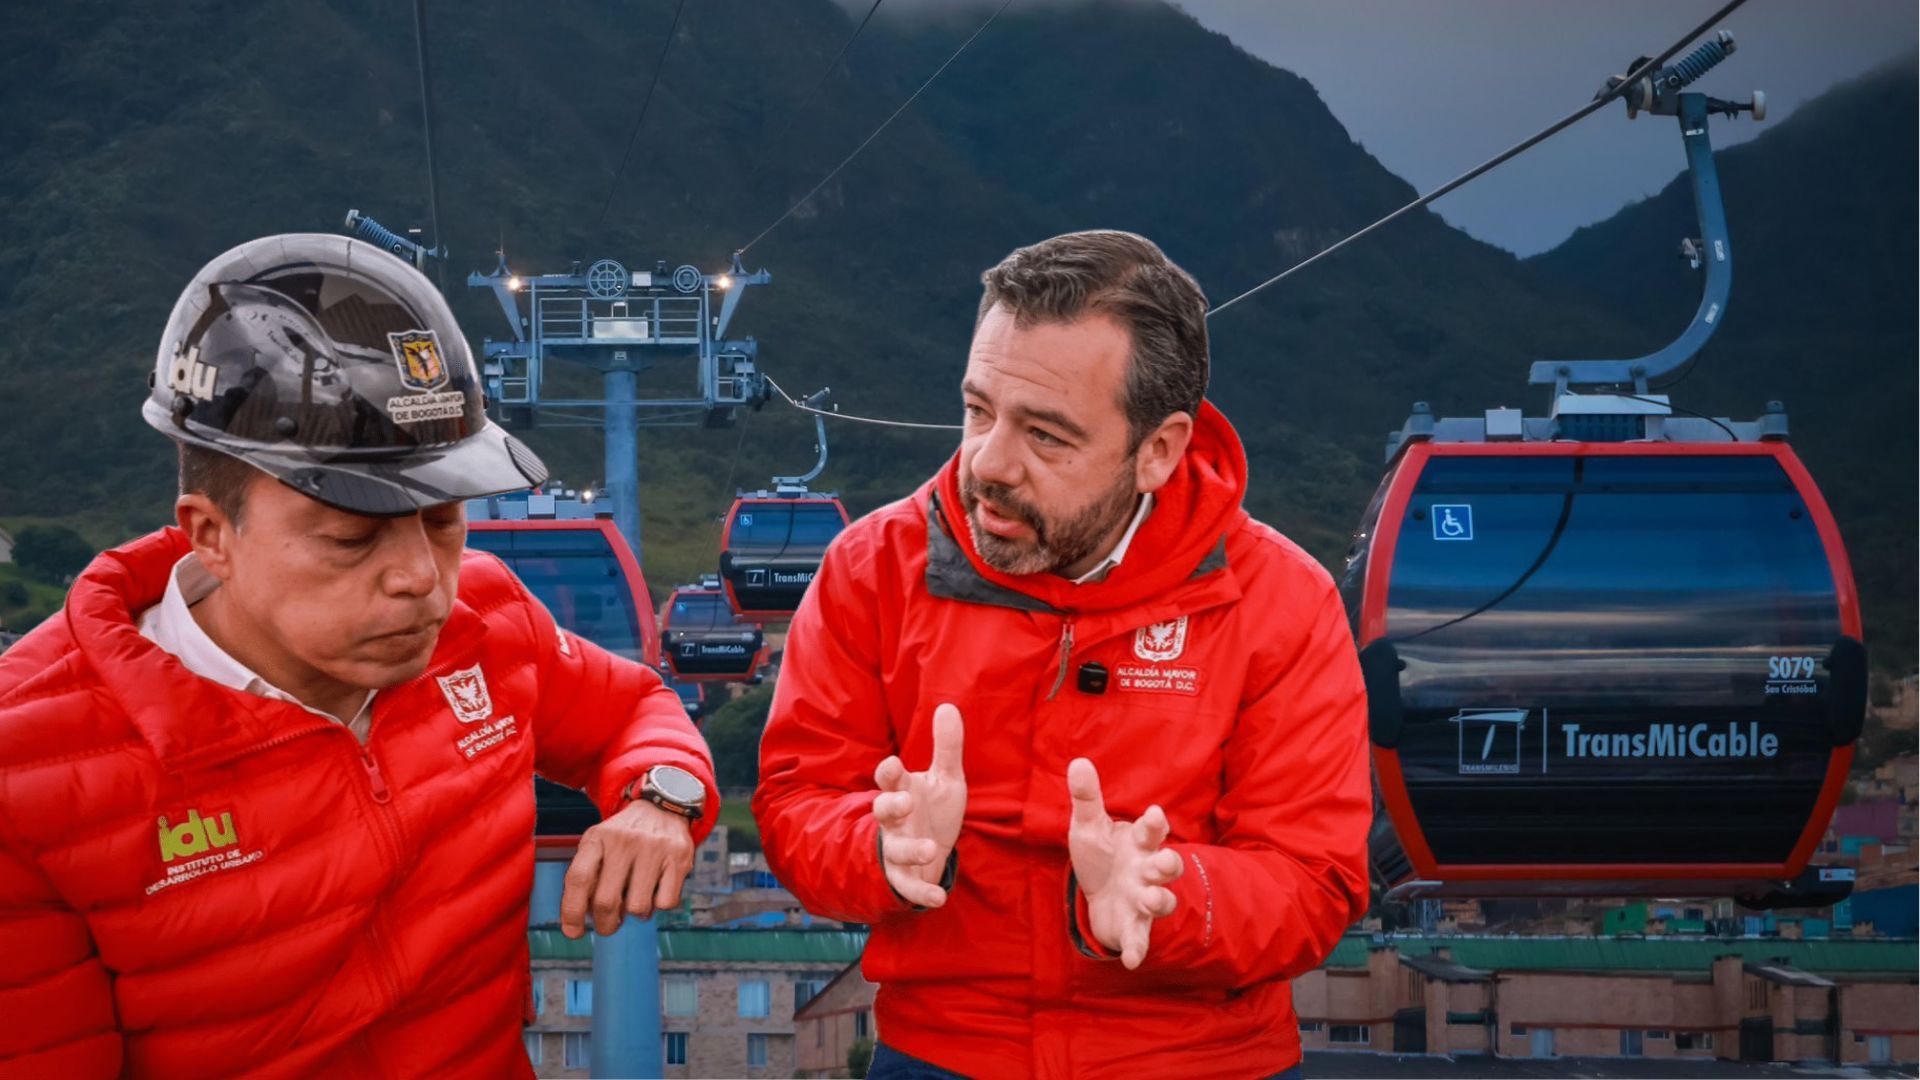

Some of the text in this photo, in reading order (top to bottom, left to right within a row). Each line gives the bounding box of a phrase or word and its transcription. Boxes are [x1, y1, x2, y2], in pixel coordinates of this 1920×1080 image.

[395, 410, 409, 420] DE
[1162, 669, 1197, 679] MAYOR
[1769, 655, 1815, 679] S079
[1120, 678, 1130, 688] DE
[1562, 721, 1779, 757] TransMiCable
[158, 809, 238, 862] idu
[167, 849, 241, 876] INSTITUTO DE
[145, 864, 218, 896] DESARROLLO
